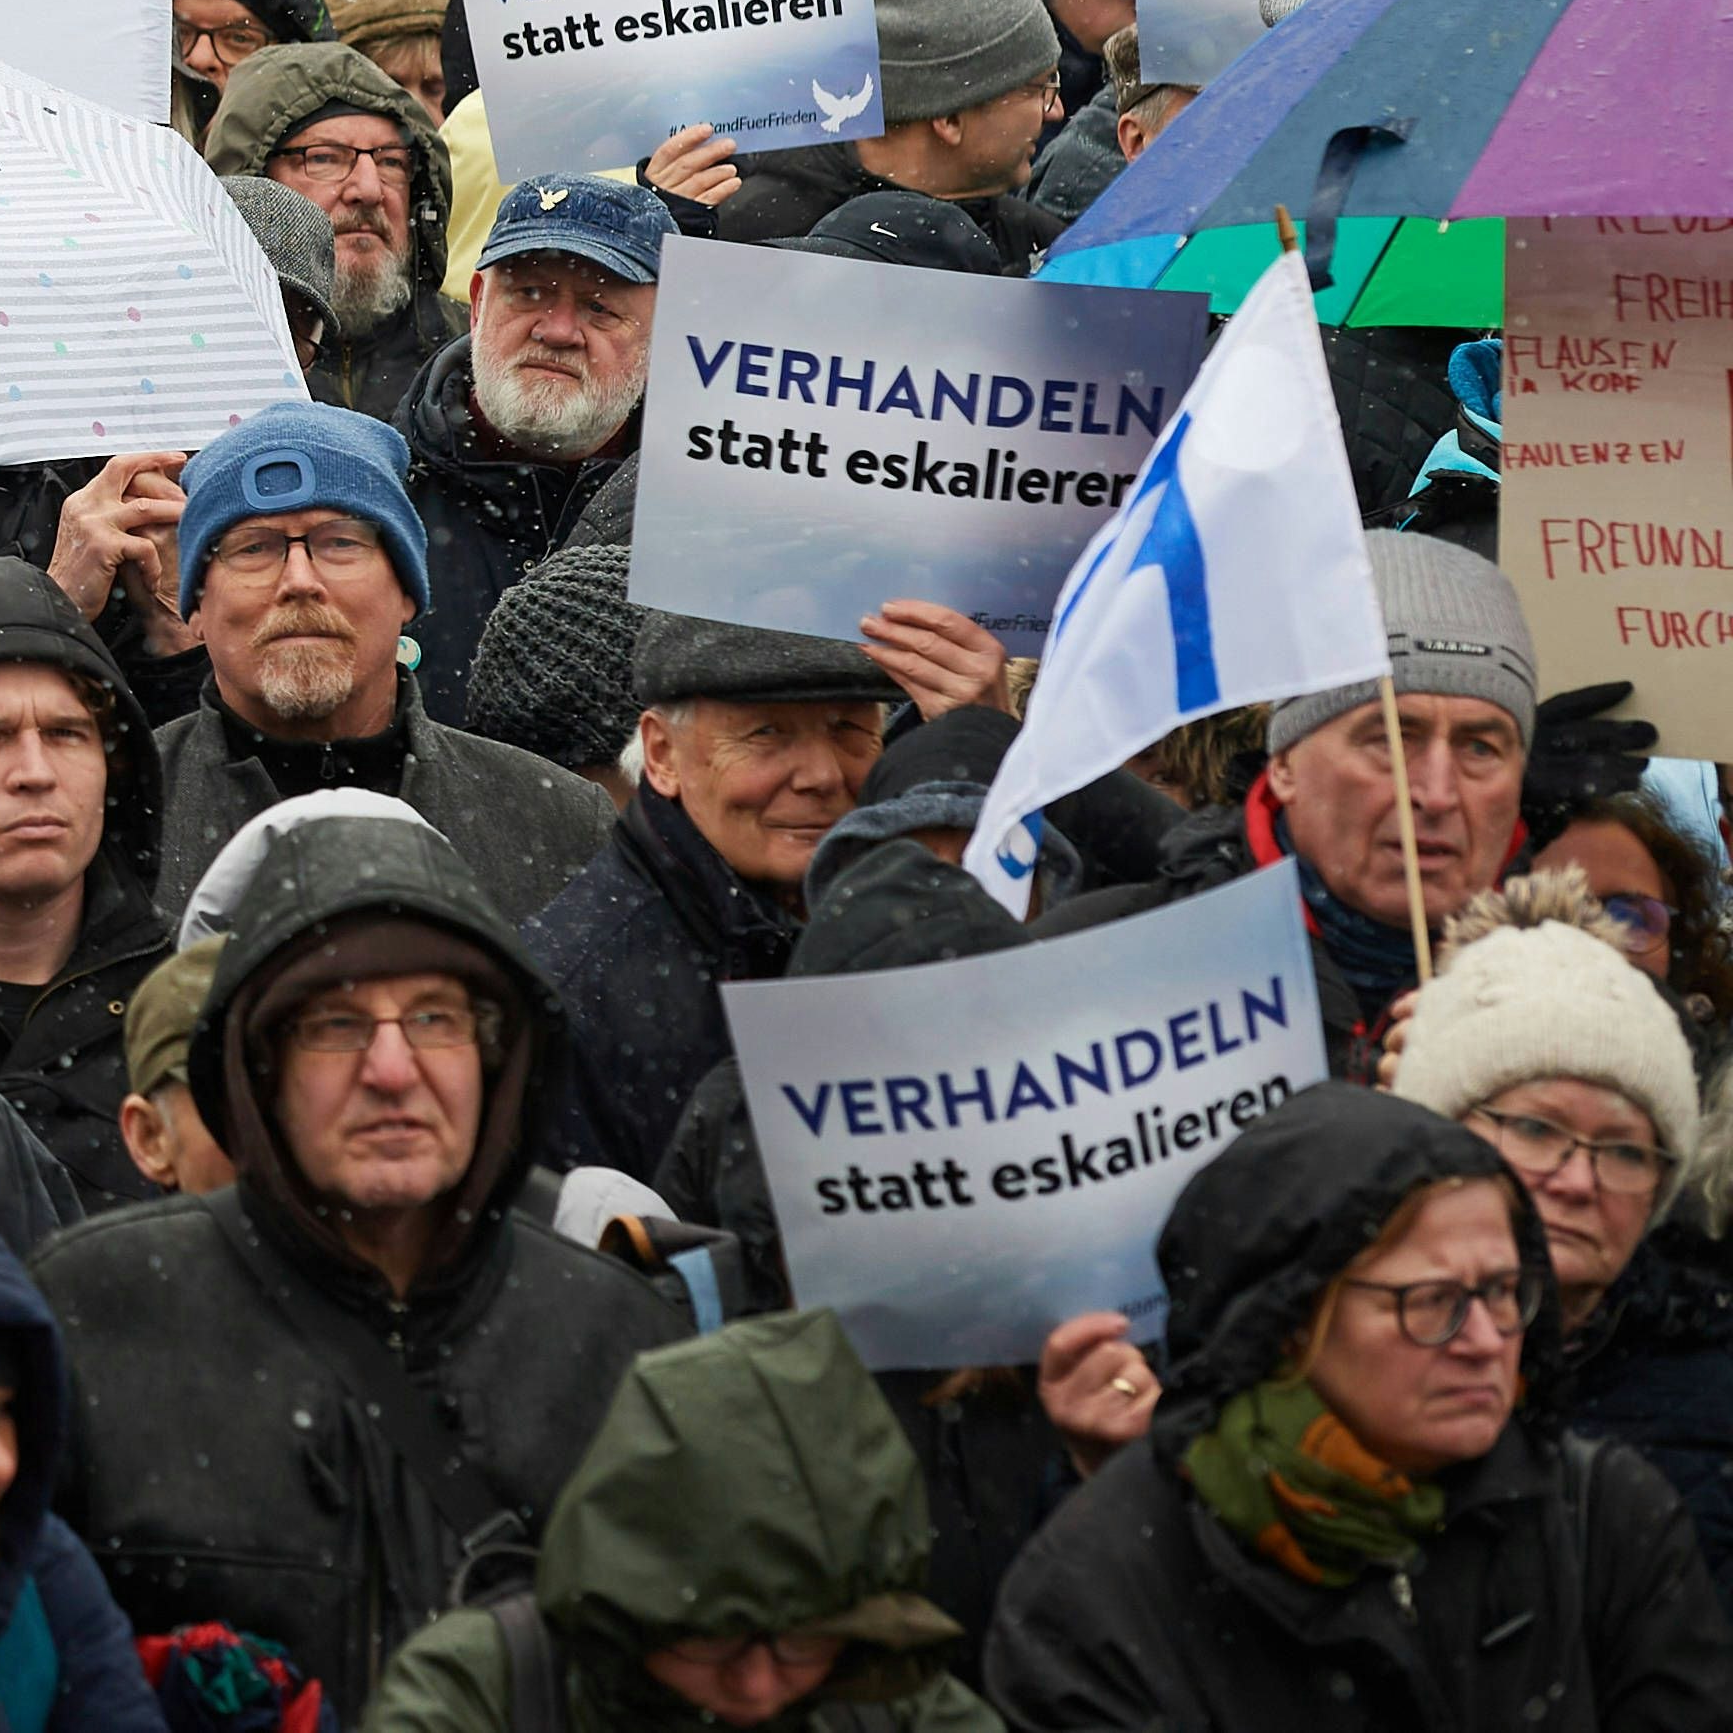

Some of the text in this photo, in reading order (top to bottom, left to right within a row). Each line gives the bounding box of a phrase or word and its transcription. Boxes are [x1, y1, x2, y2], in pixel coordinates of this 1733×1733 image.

[503, 13, 604, 60] statt
[686, 335, 1165, 439] VERHANDELN
[1560, 371, 1644, 394] KOPF
[686, 419, 829, 479] statt
[1502, 439, 1685, 469] FAULENZEN
[780, 975, 1289, 1138] VERHANDELN
[816, 1159, 974, 1216] statt
